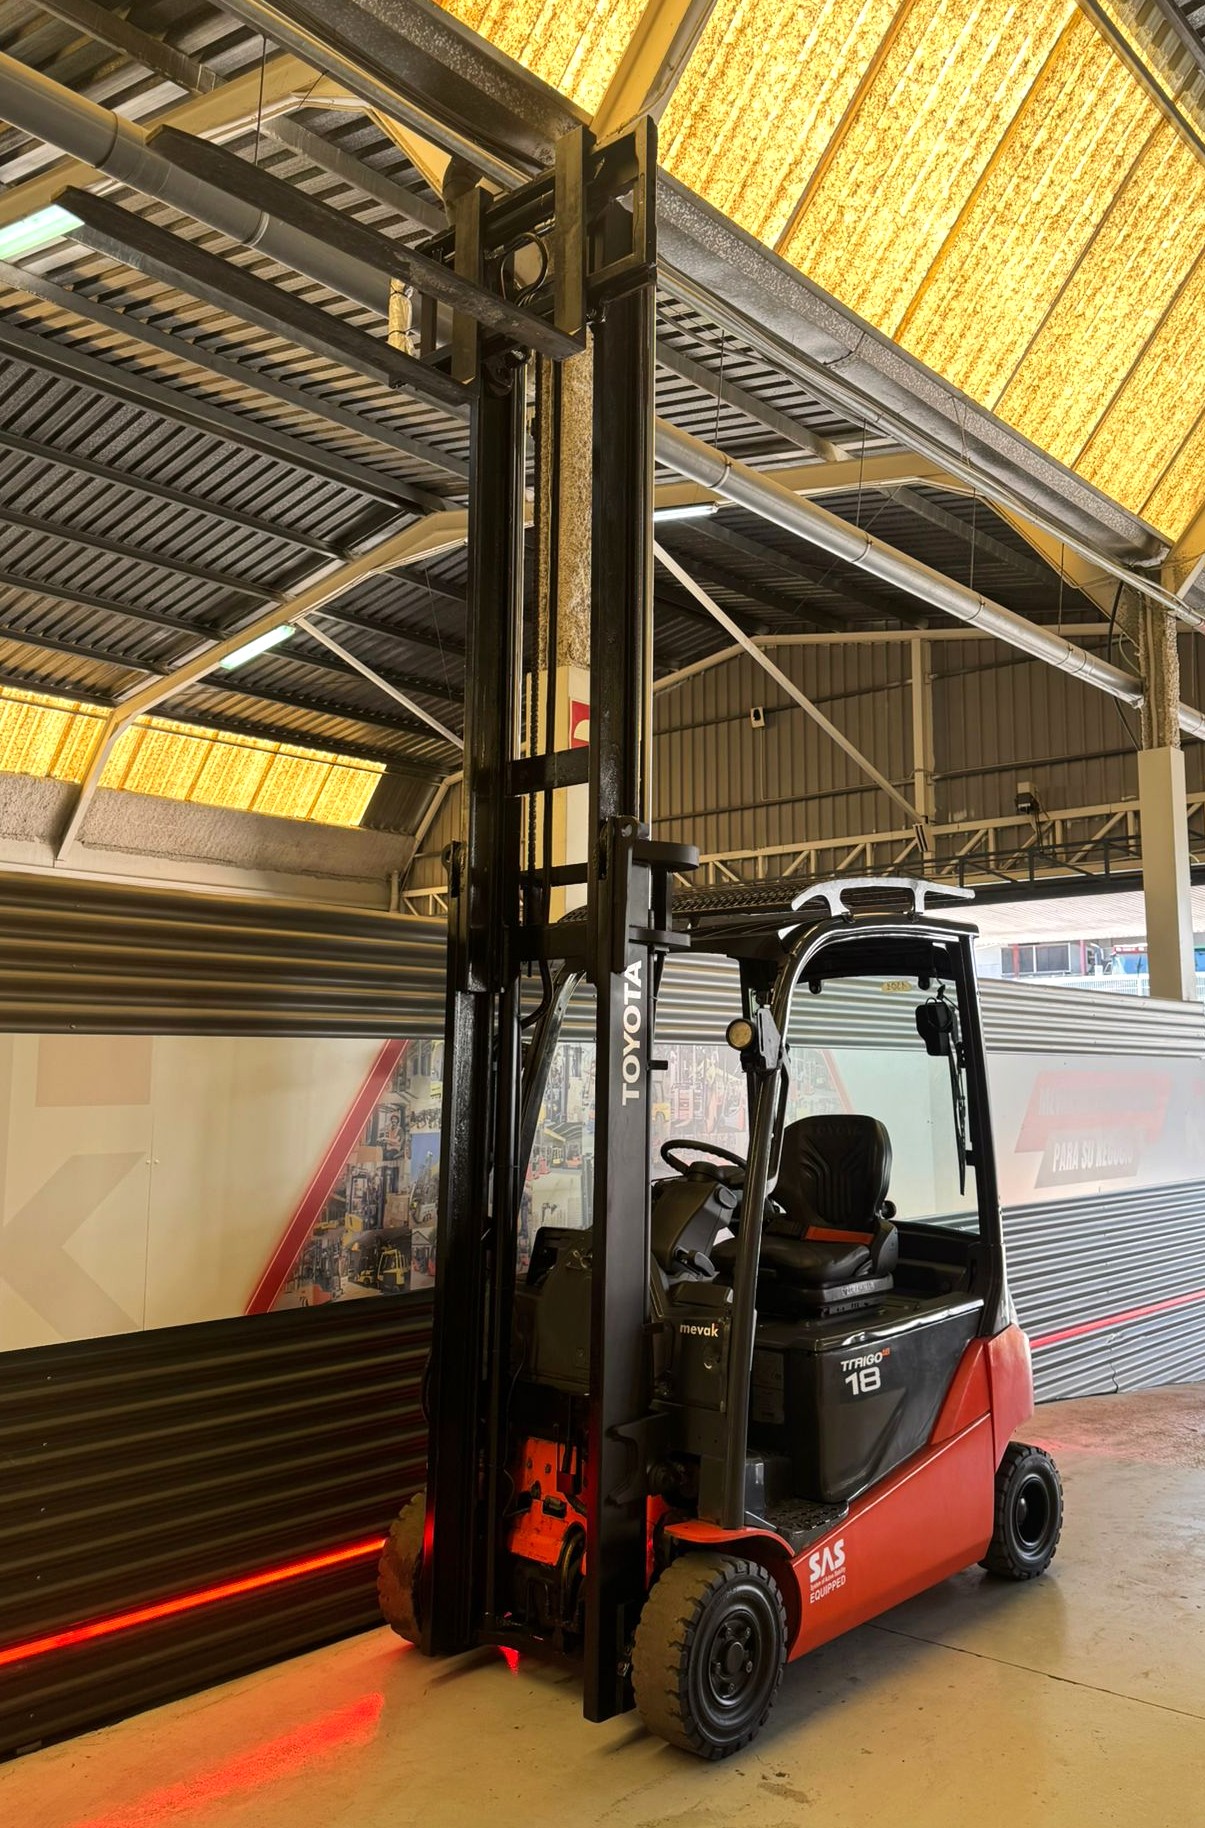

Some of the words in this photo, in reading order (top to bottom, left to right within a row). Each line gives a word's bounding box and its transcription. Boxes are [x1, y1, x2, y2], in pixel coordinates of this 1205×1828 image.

[621, 959, 642, 1107] TOYOTA
[1052, 1142, 1078, 1172] PARA
[1081, 1140, 1095, 1169] SU
[680, 1322, 719, 1338] mevak
[845, 1366, 881, 1396] 18
[809, 1538, 846, 1584] SAS
[809, 1574, 847, 1604] EQUIPPED
